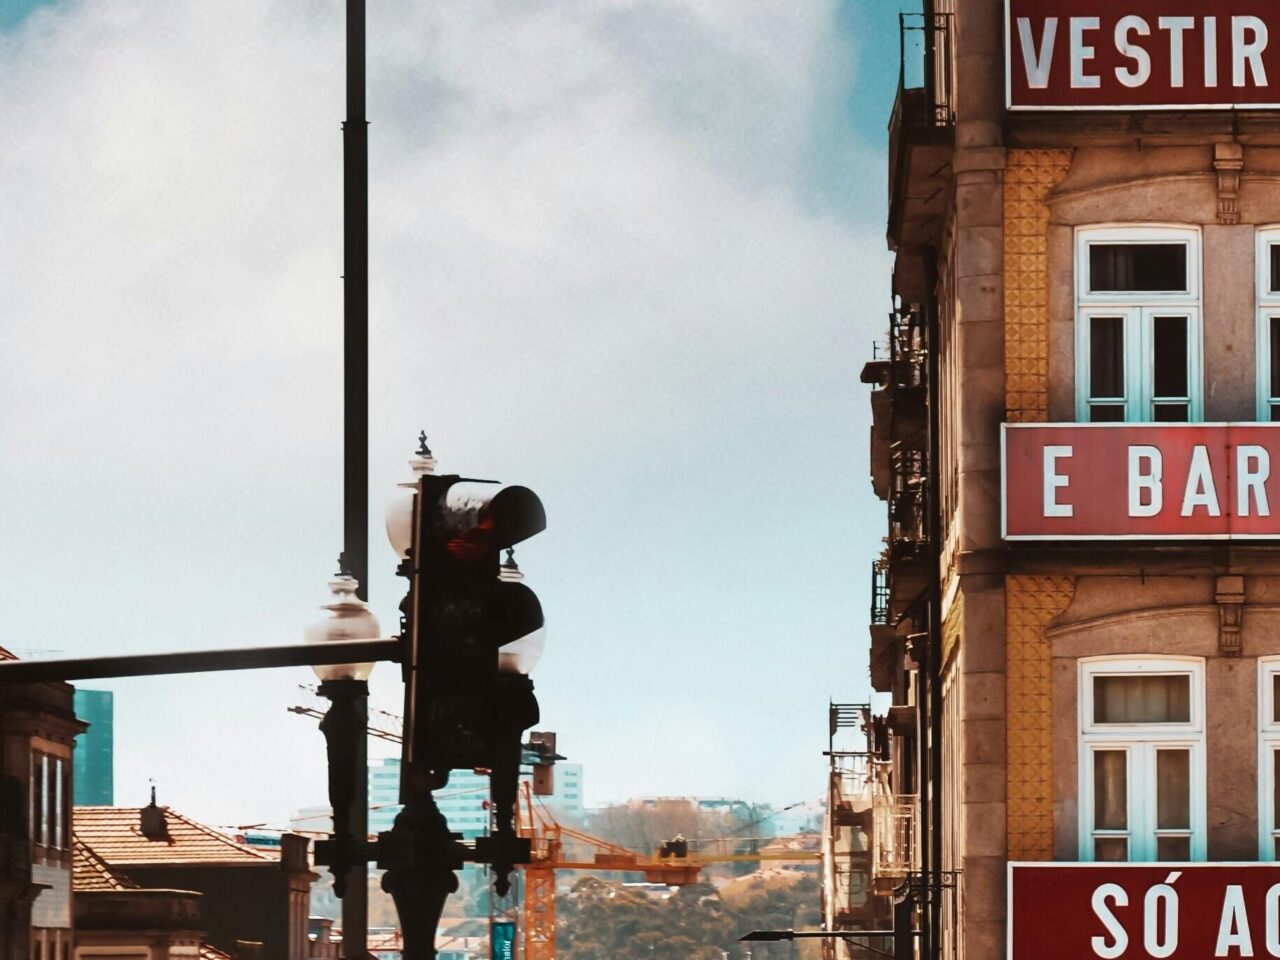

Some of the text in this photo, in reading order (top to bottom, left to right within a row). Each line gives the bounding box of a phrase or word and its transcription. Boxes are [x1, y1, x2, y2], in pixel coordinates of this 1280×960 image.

[1016, 14, 1269, 89] VESTIR
[1043, 445, 1074, 517] E
[1091, 871, 1183, 960] SÓ
